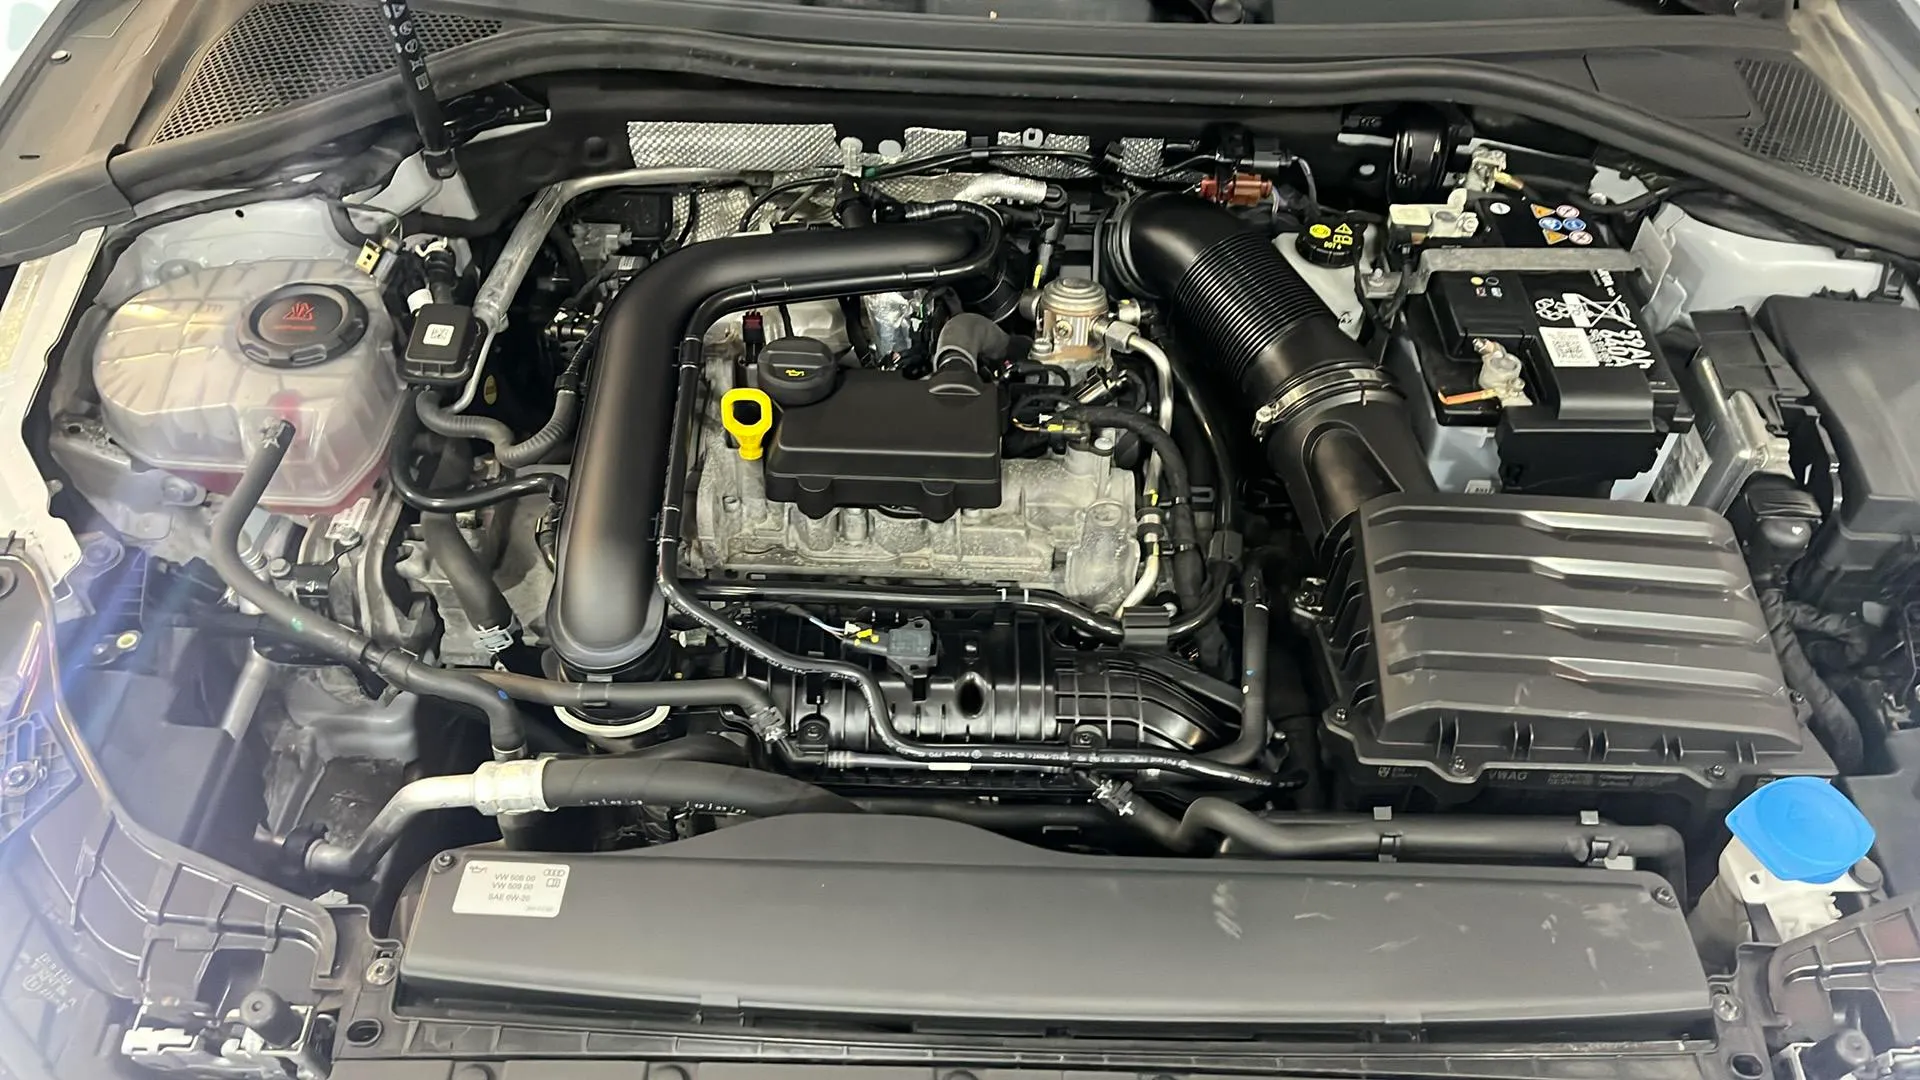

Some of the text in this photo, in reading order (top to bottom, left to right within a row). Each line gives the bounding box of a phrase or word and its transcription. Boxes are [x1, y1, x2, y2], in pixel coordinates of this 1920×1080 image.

[1619, 329, 1655, 369] 59Ah
[1488, 770, 1528, 781] VWAG
[492, 881, 507, 889] VW
[488, 892, 504, 901] SAE
